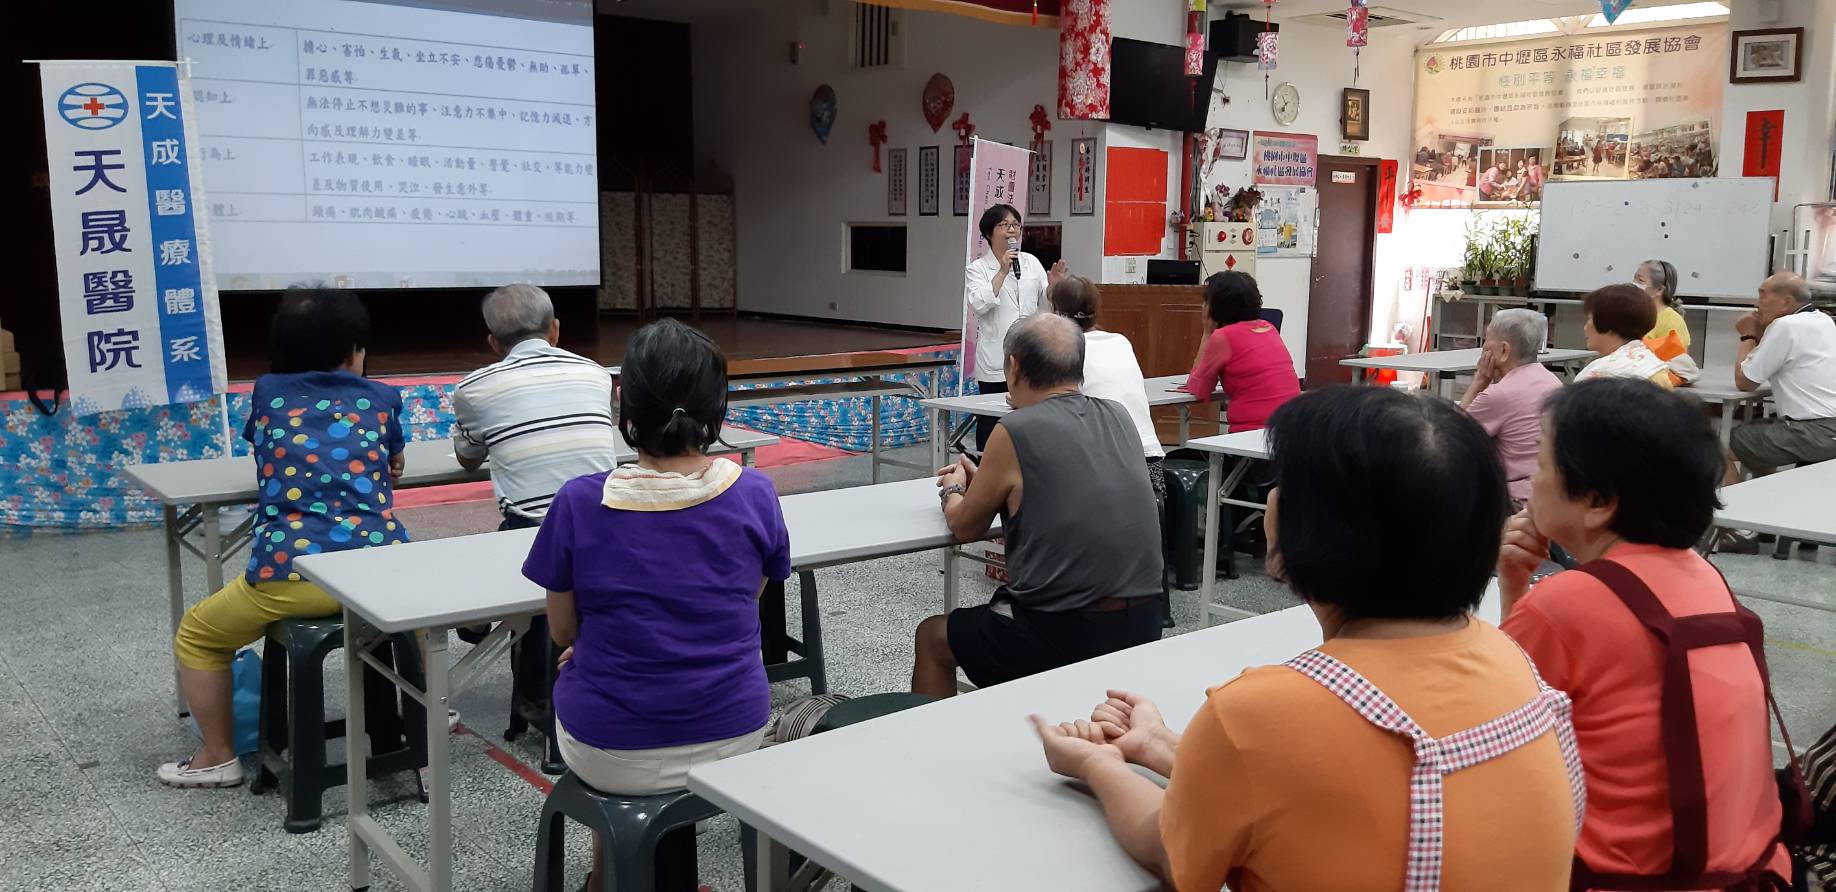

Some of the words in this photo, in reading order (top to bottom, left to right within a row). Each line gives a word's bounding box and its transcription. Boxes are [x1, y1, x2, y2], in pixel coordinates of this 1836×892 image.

[1449, 35, 1702, 70] 桃園市中壢區永福社區發展協會
[1498, 71, 1554, 87] 性別平等
[72, 149, 142, 374] 天晟醫院
[145, 92, 202, 364] 天成醫療體系
